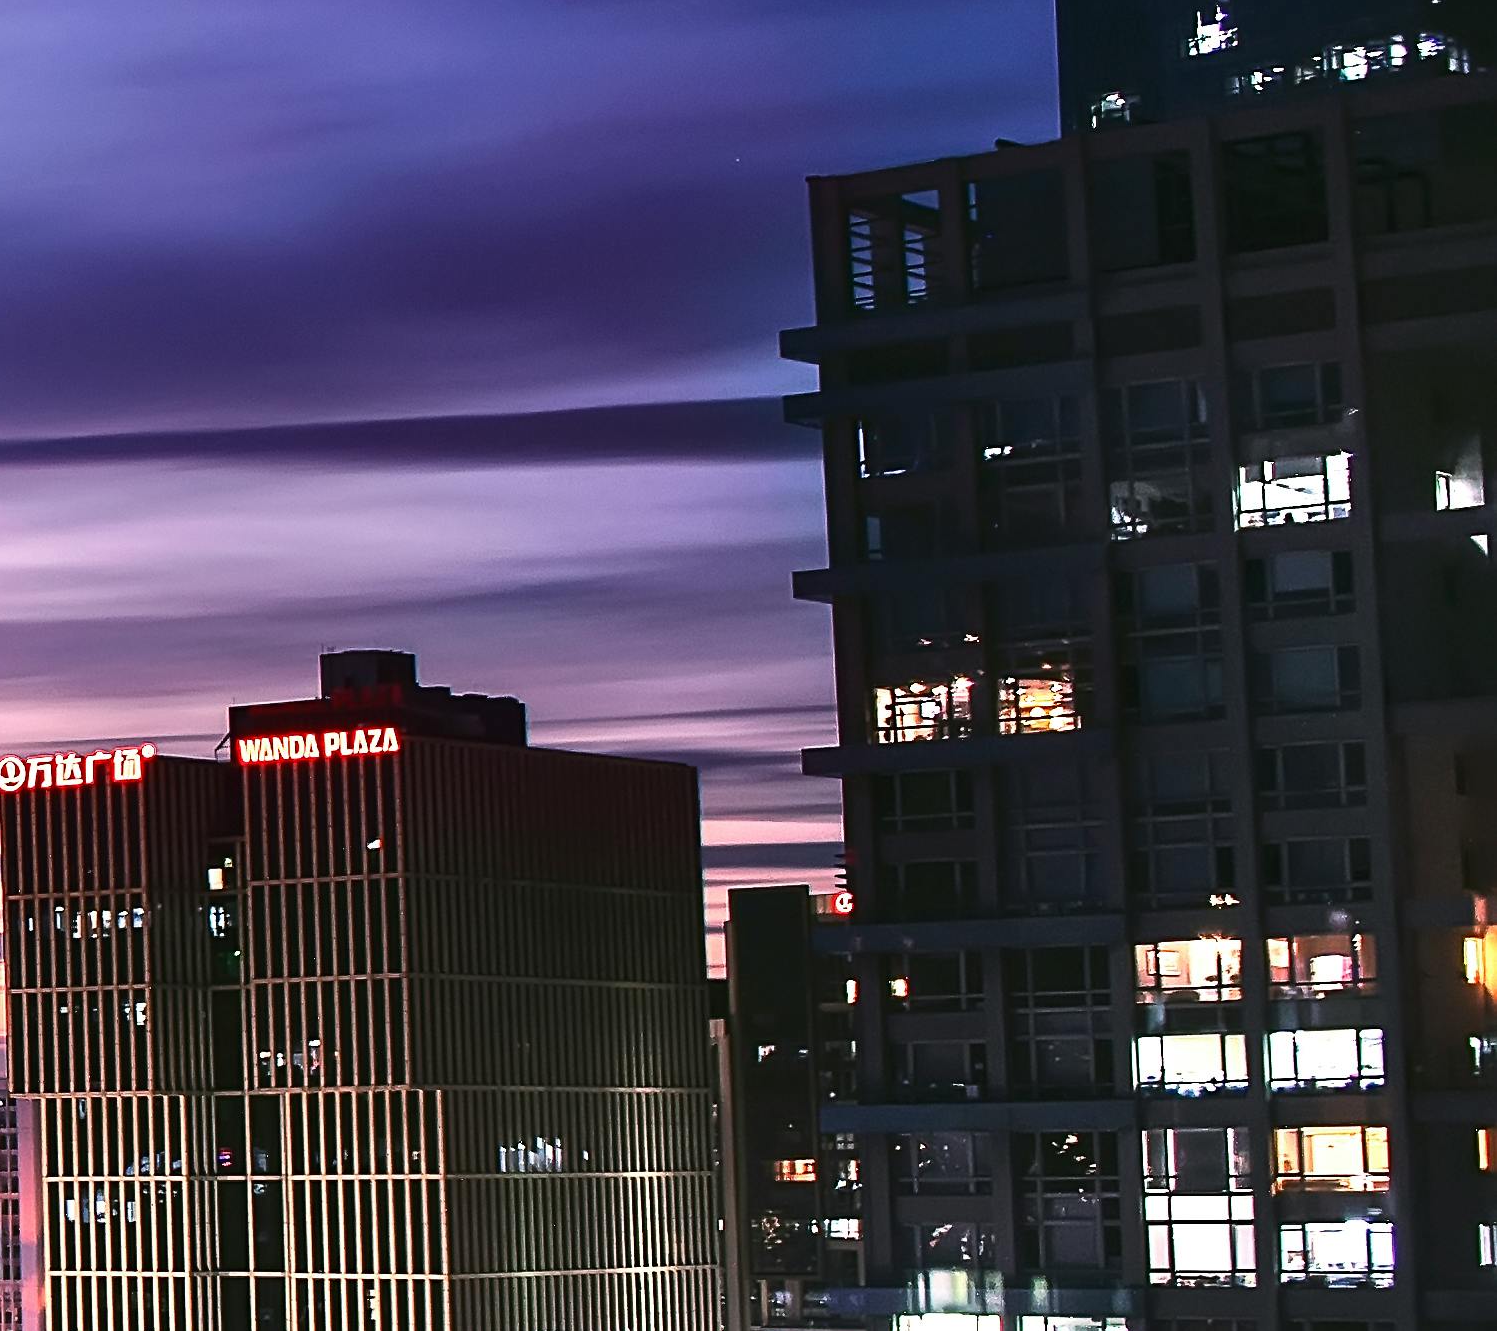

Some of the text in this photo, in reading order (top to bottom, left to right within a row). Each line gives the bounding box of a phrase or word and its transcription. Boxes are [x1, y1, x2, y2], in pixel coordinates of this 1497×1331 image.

[238, 727, 400, 763] WANDA PLAZA
[26, 748, 142, 789] 万达广场
